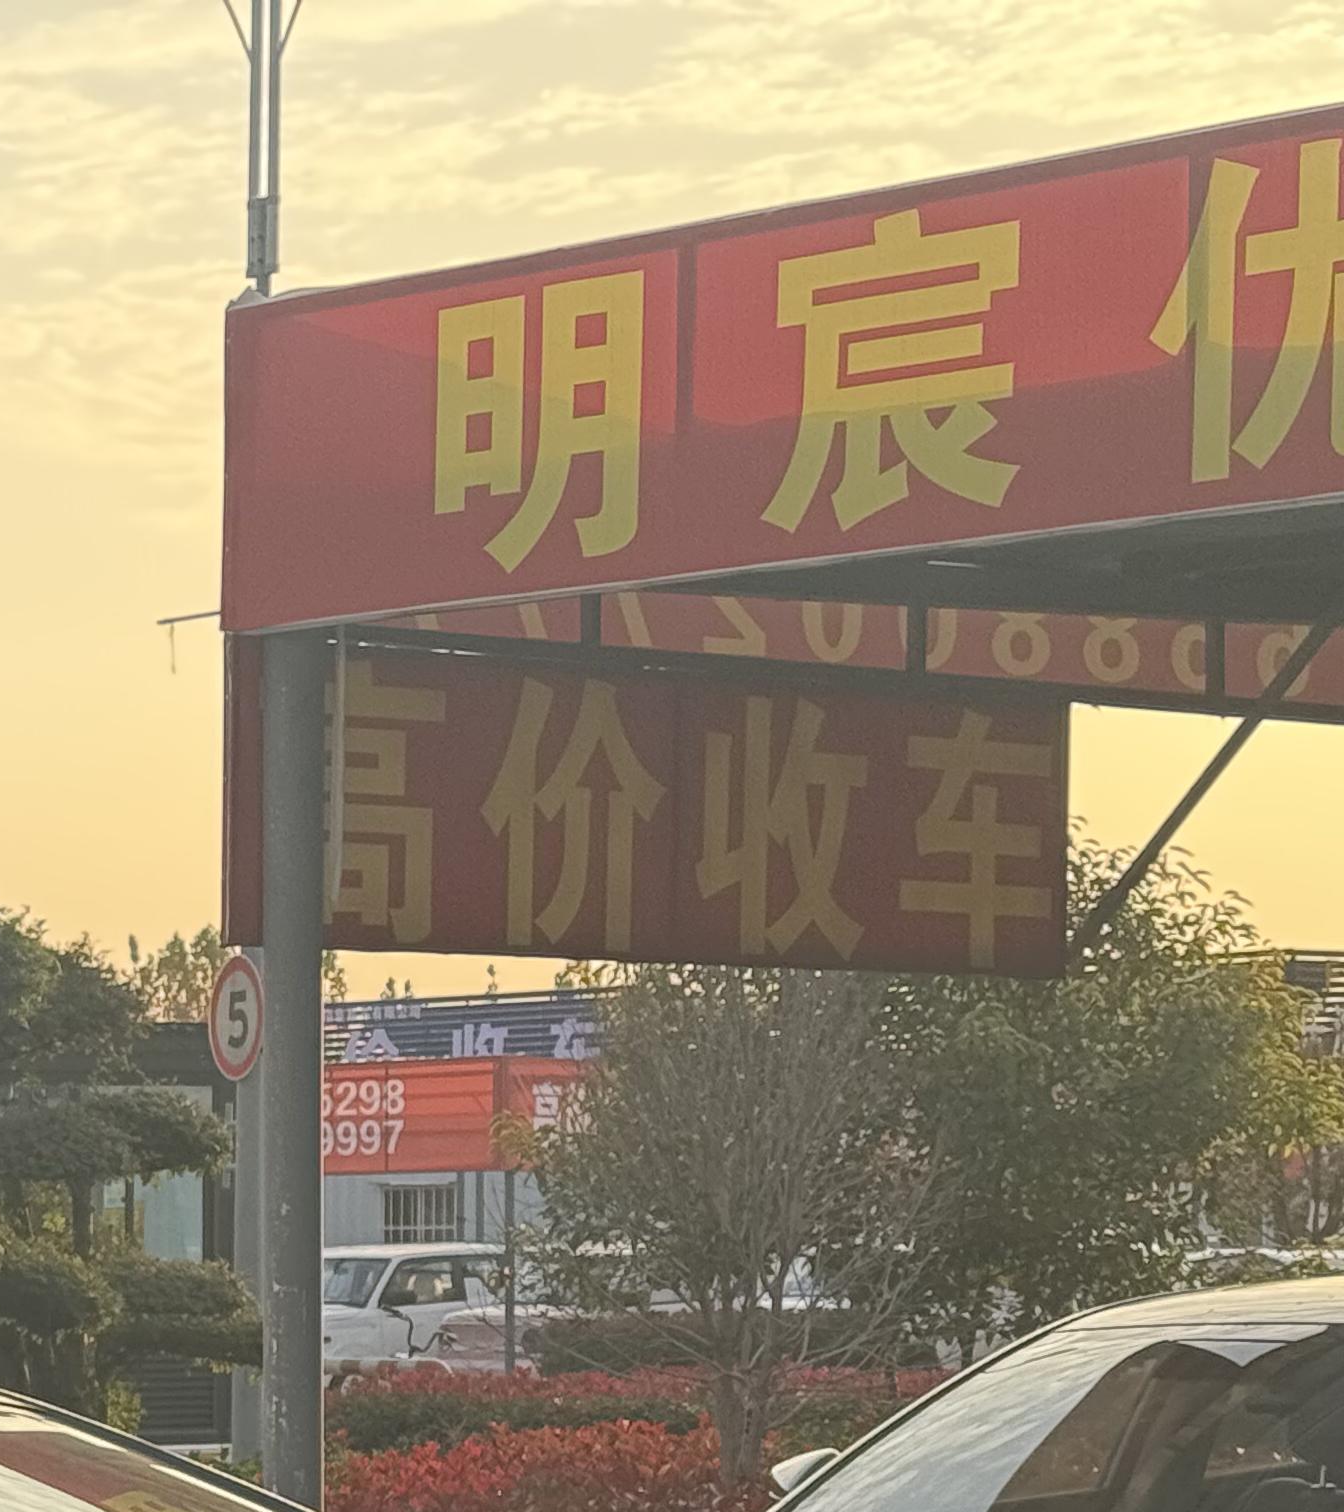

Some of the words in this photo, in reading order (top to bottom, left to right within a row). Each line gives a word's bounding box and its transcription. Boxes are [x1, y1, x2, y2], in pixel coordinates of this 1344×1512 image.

[433, 137, 1344, 573] 明宸优
[324, 658, 1054, 969] 高价收车
[227, 990, 249, 1049] 5
